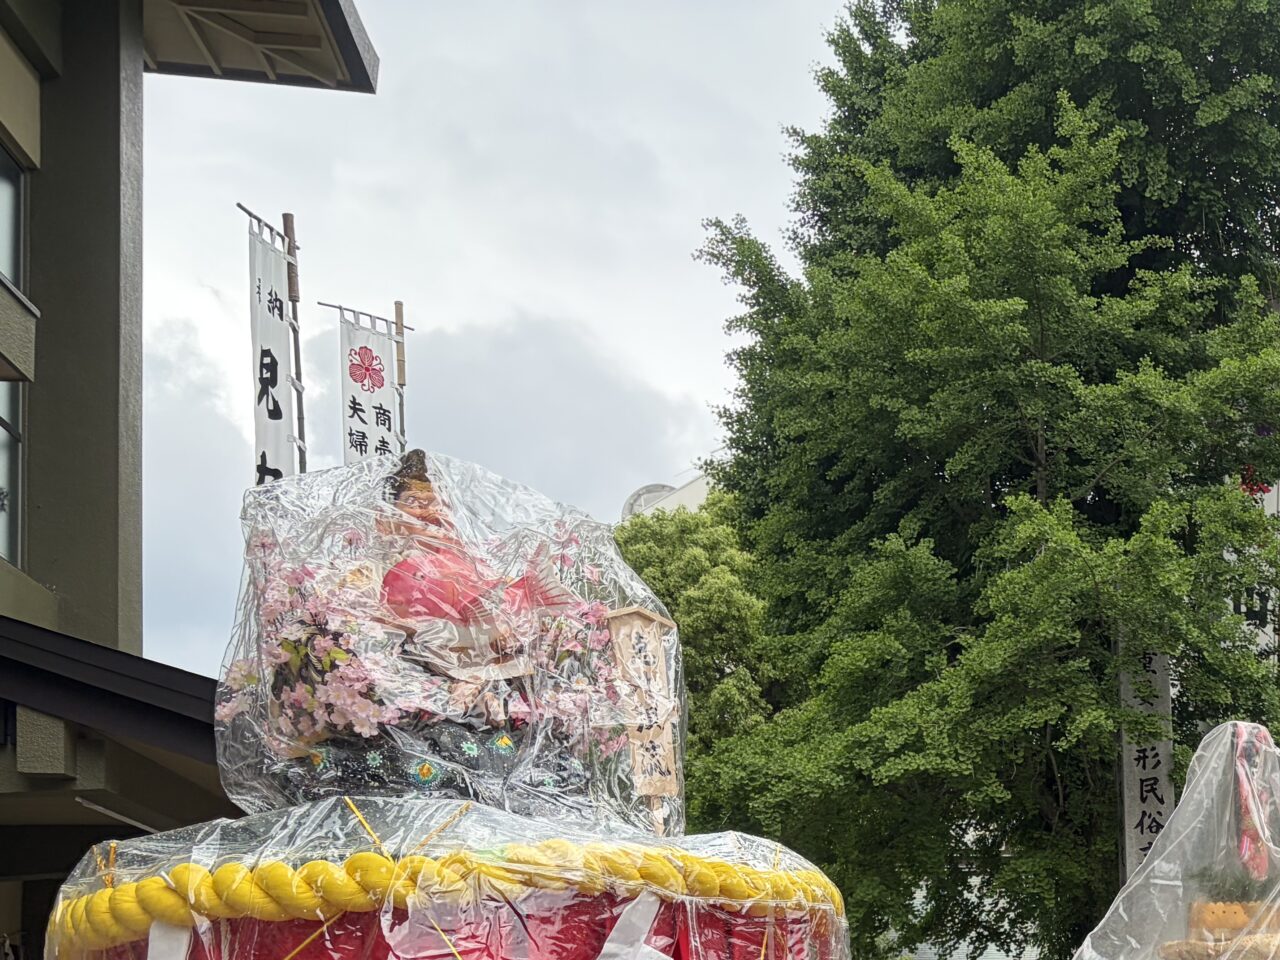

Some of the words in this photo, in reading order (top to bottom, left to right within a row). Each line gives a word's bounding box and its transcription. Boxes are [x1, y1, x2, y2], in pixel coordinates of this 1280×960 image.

[266, 285, 284, 322] 納
[347, 394, 368, 456] 夫婦
[372, 403, 392, 456] 商売
